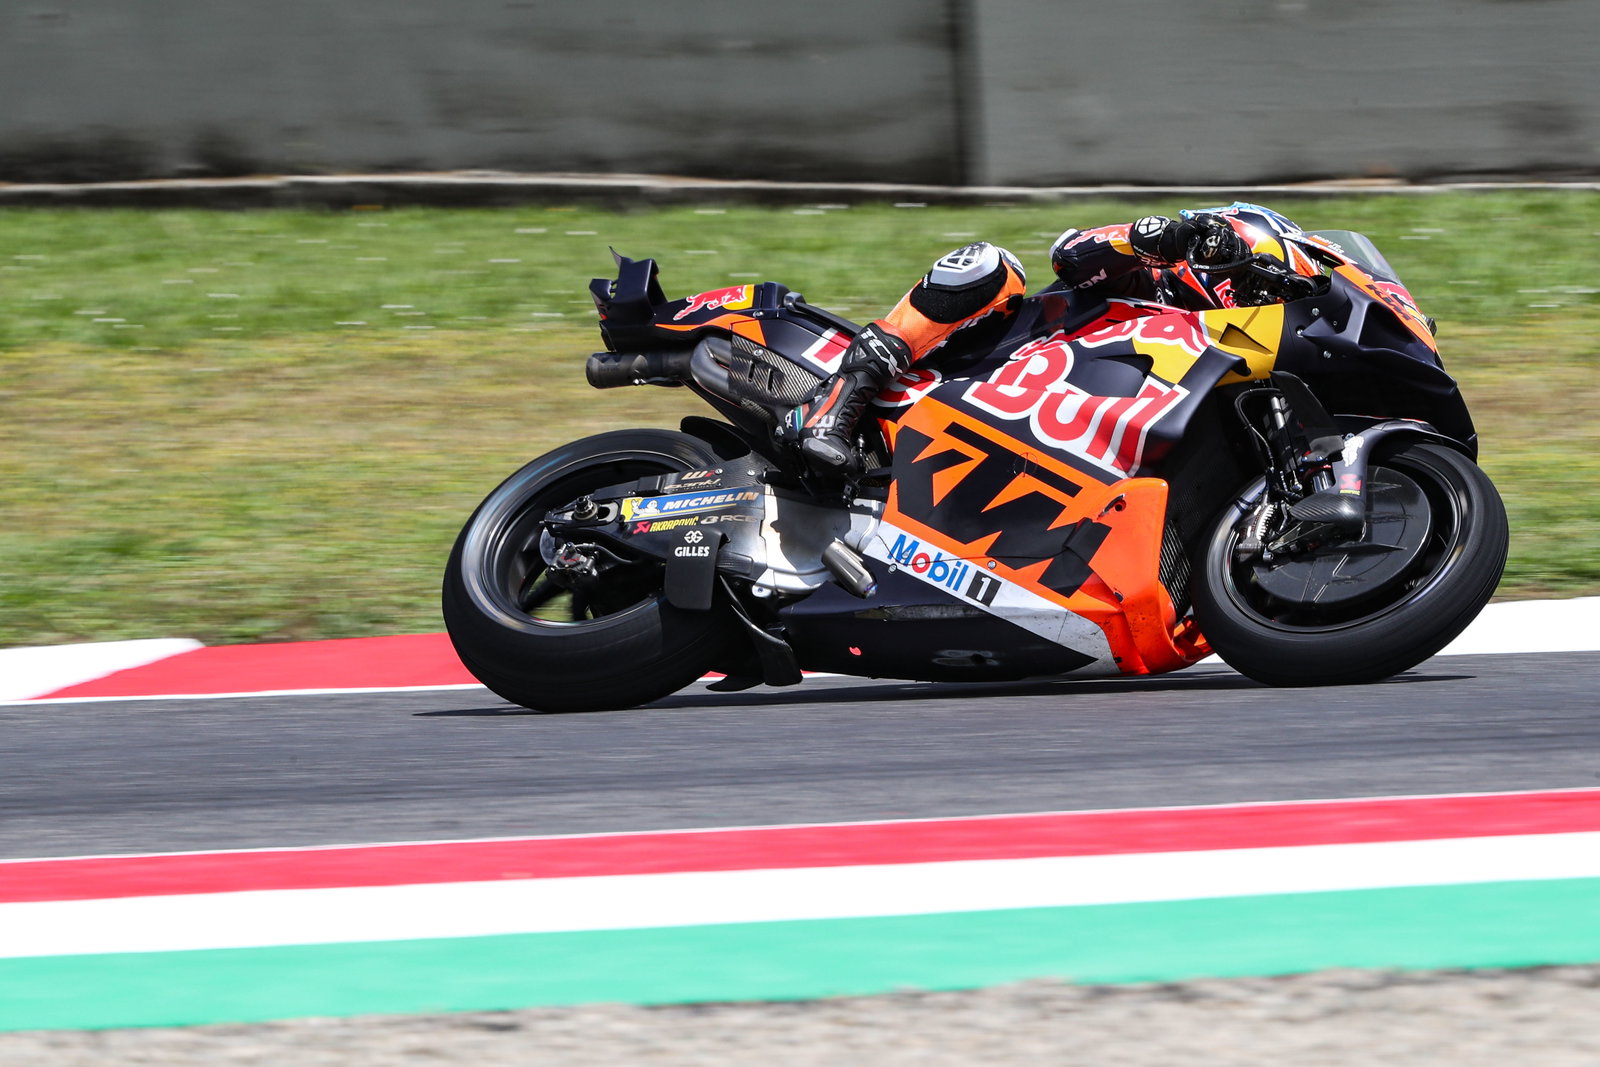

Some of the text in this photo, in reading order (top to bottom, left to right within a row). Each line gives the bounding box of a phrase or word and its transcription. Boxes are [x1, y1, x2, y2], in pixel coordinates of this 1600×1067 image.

[861, 327, 903, 377] TCX
[962, 342, 1190, 478] Bull
[662, 491, 760, 511] MICHELIN
[891, 424, 1112, 599] KTM
[674, 546, 710, 558] GILLES
[887, 533, 969, 592] Mobil
